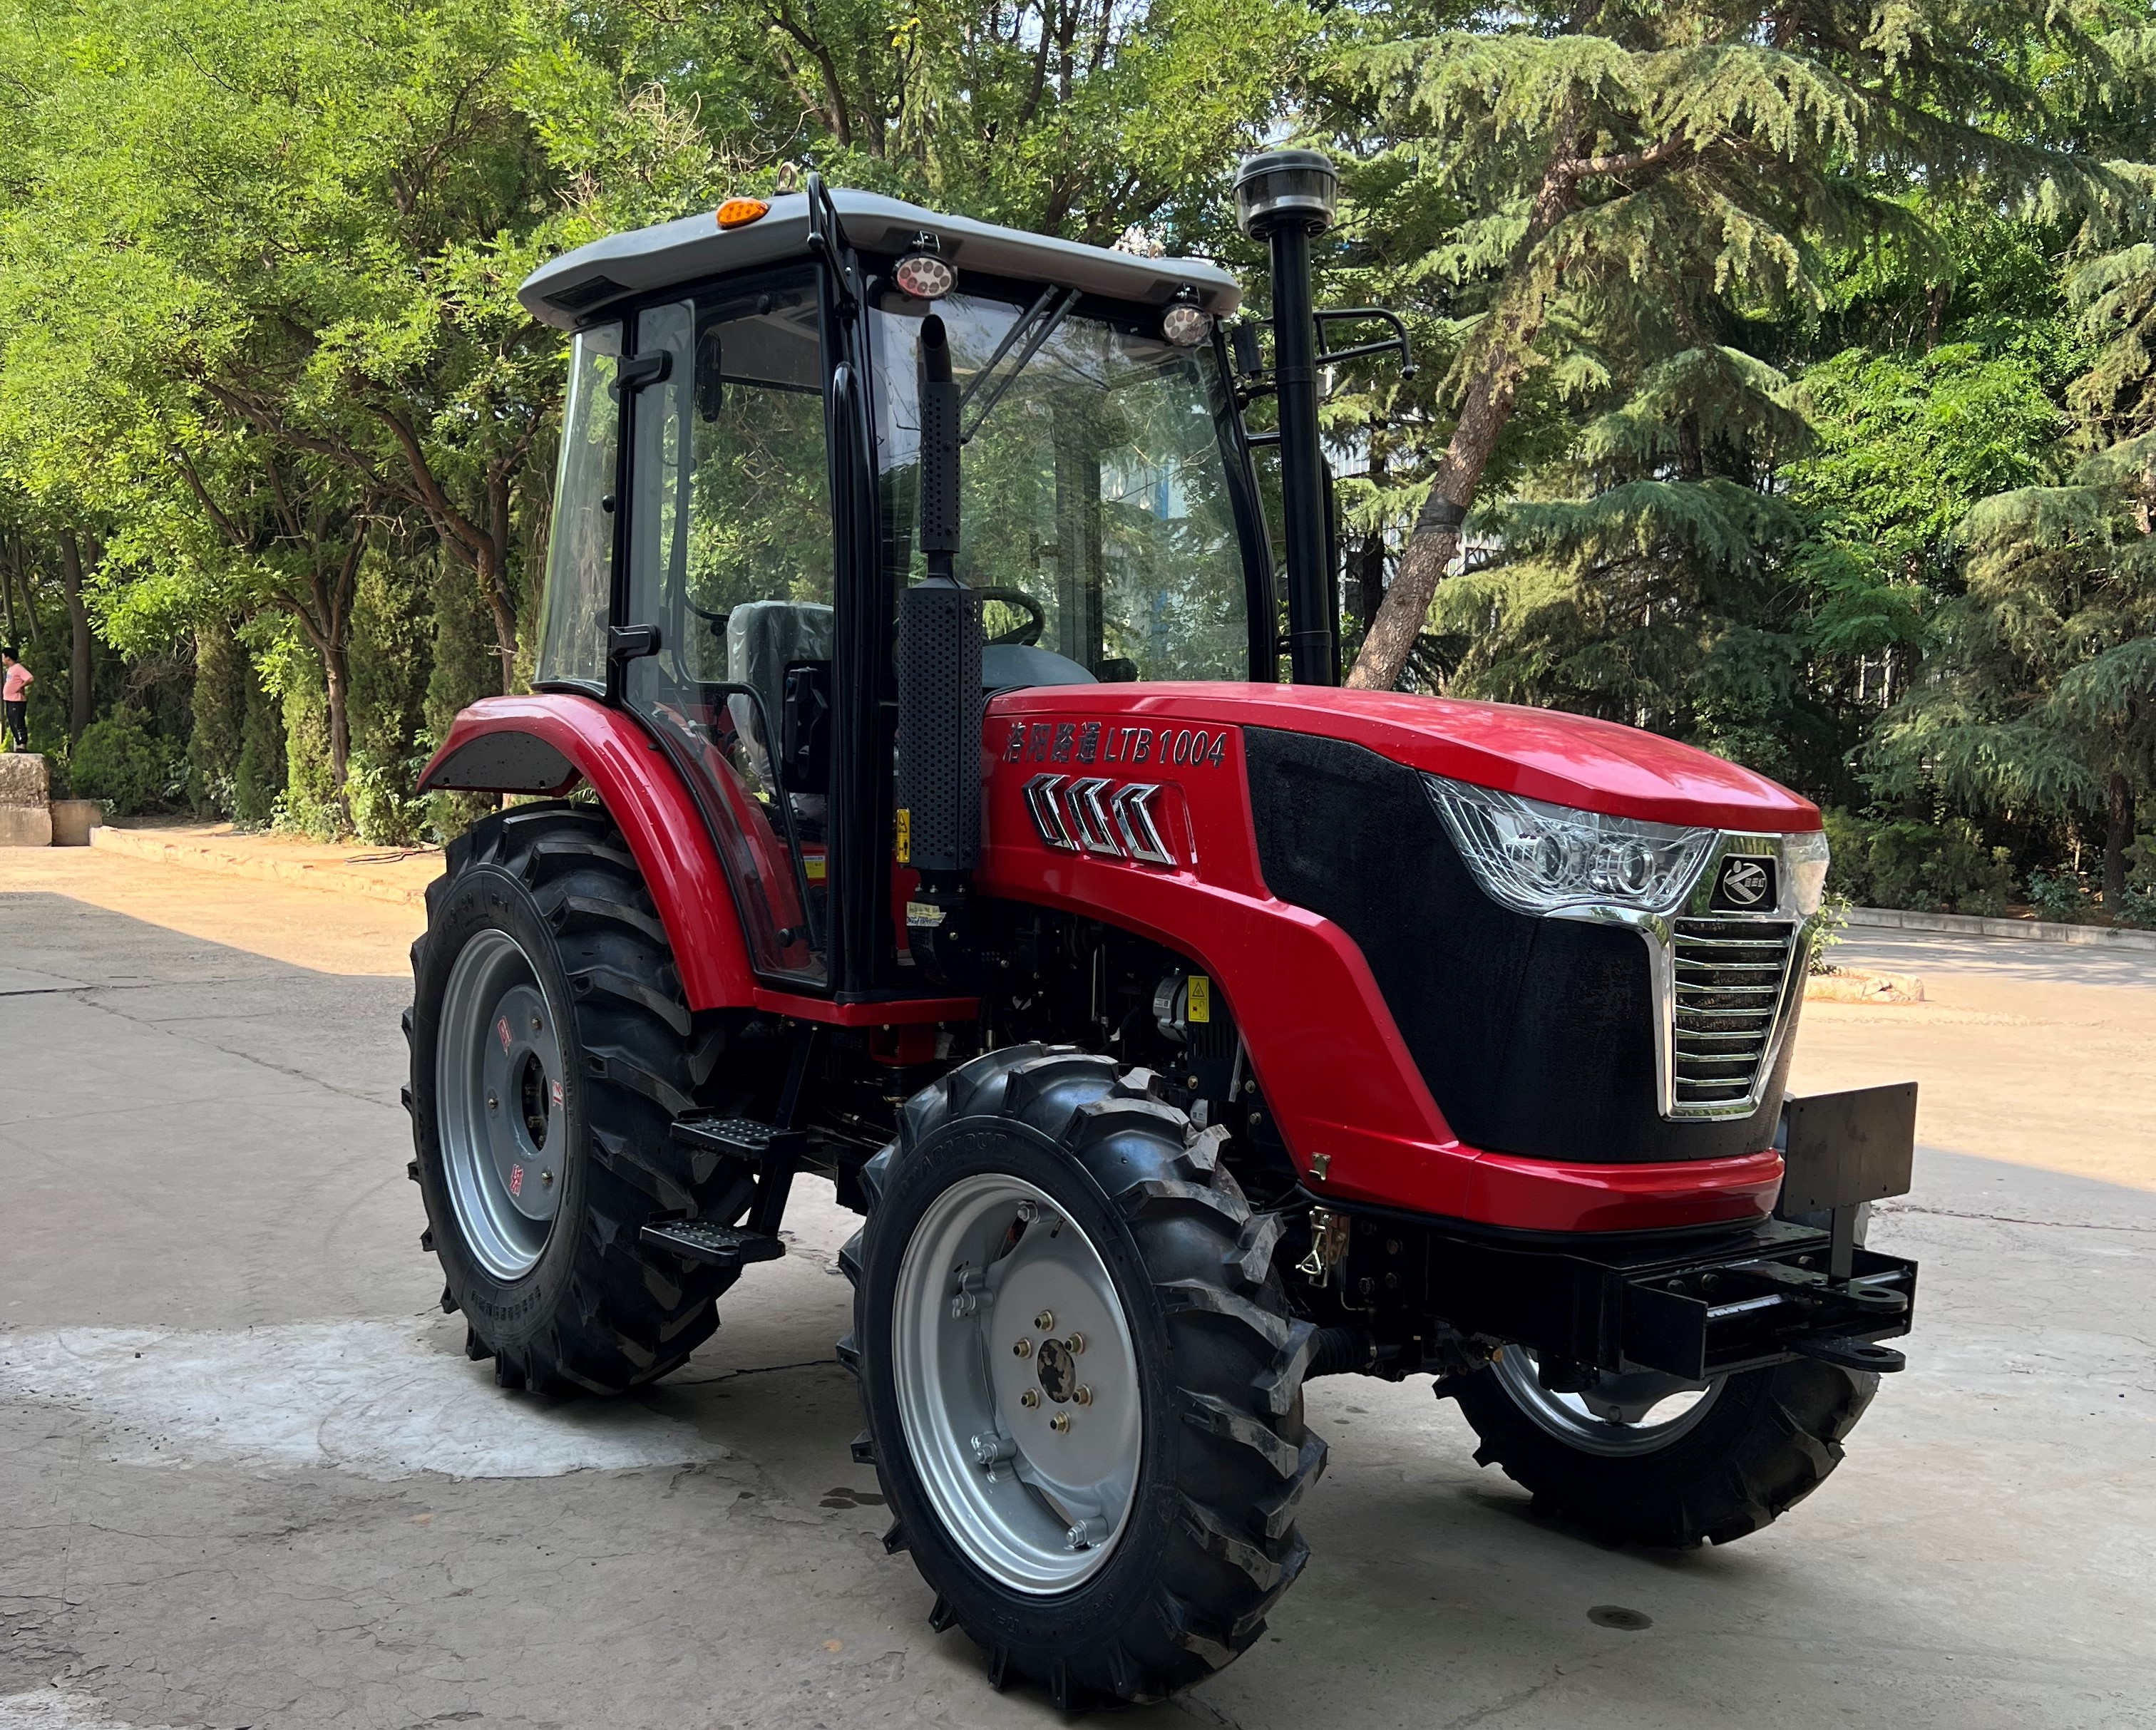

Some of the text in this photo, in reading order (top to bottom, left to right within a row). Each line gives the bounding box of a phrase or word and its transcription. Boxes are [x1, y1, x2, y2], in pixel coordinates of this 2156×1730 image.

[1002, 721, 1102, 763] 洛阳路通
[921, 1131, 1008, 1177] ARMOUR
